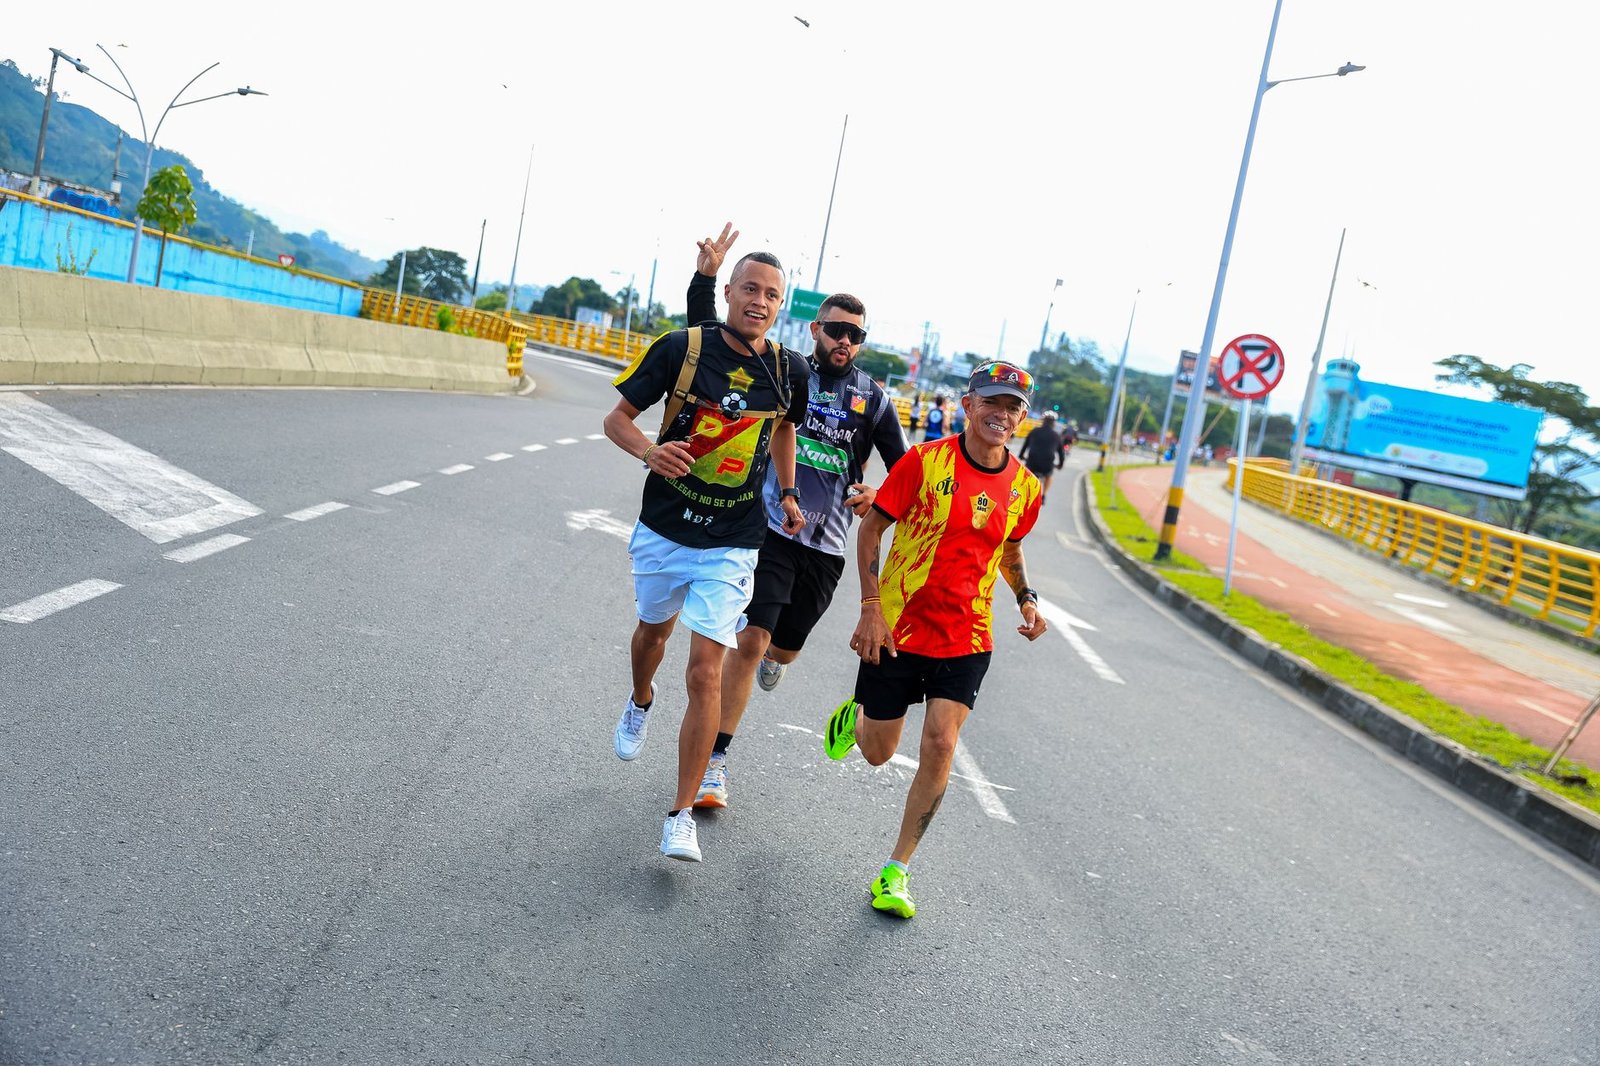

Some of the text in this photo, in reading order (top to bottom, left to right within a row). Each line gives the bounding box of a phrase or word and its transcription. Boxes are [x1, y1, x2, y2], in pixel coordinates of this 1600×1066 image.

[807, 402, 847, 419] perGIROS
[699, 495, 712, 505] NO
[713, 498, 725, 507] SE
[977, 497, 988, 507] 80
